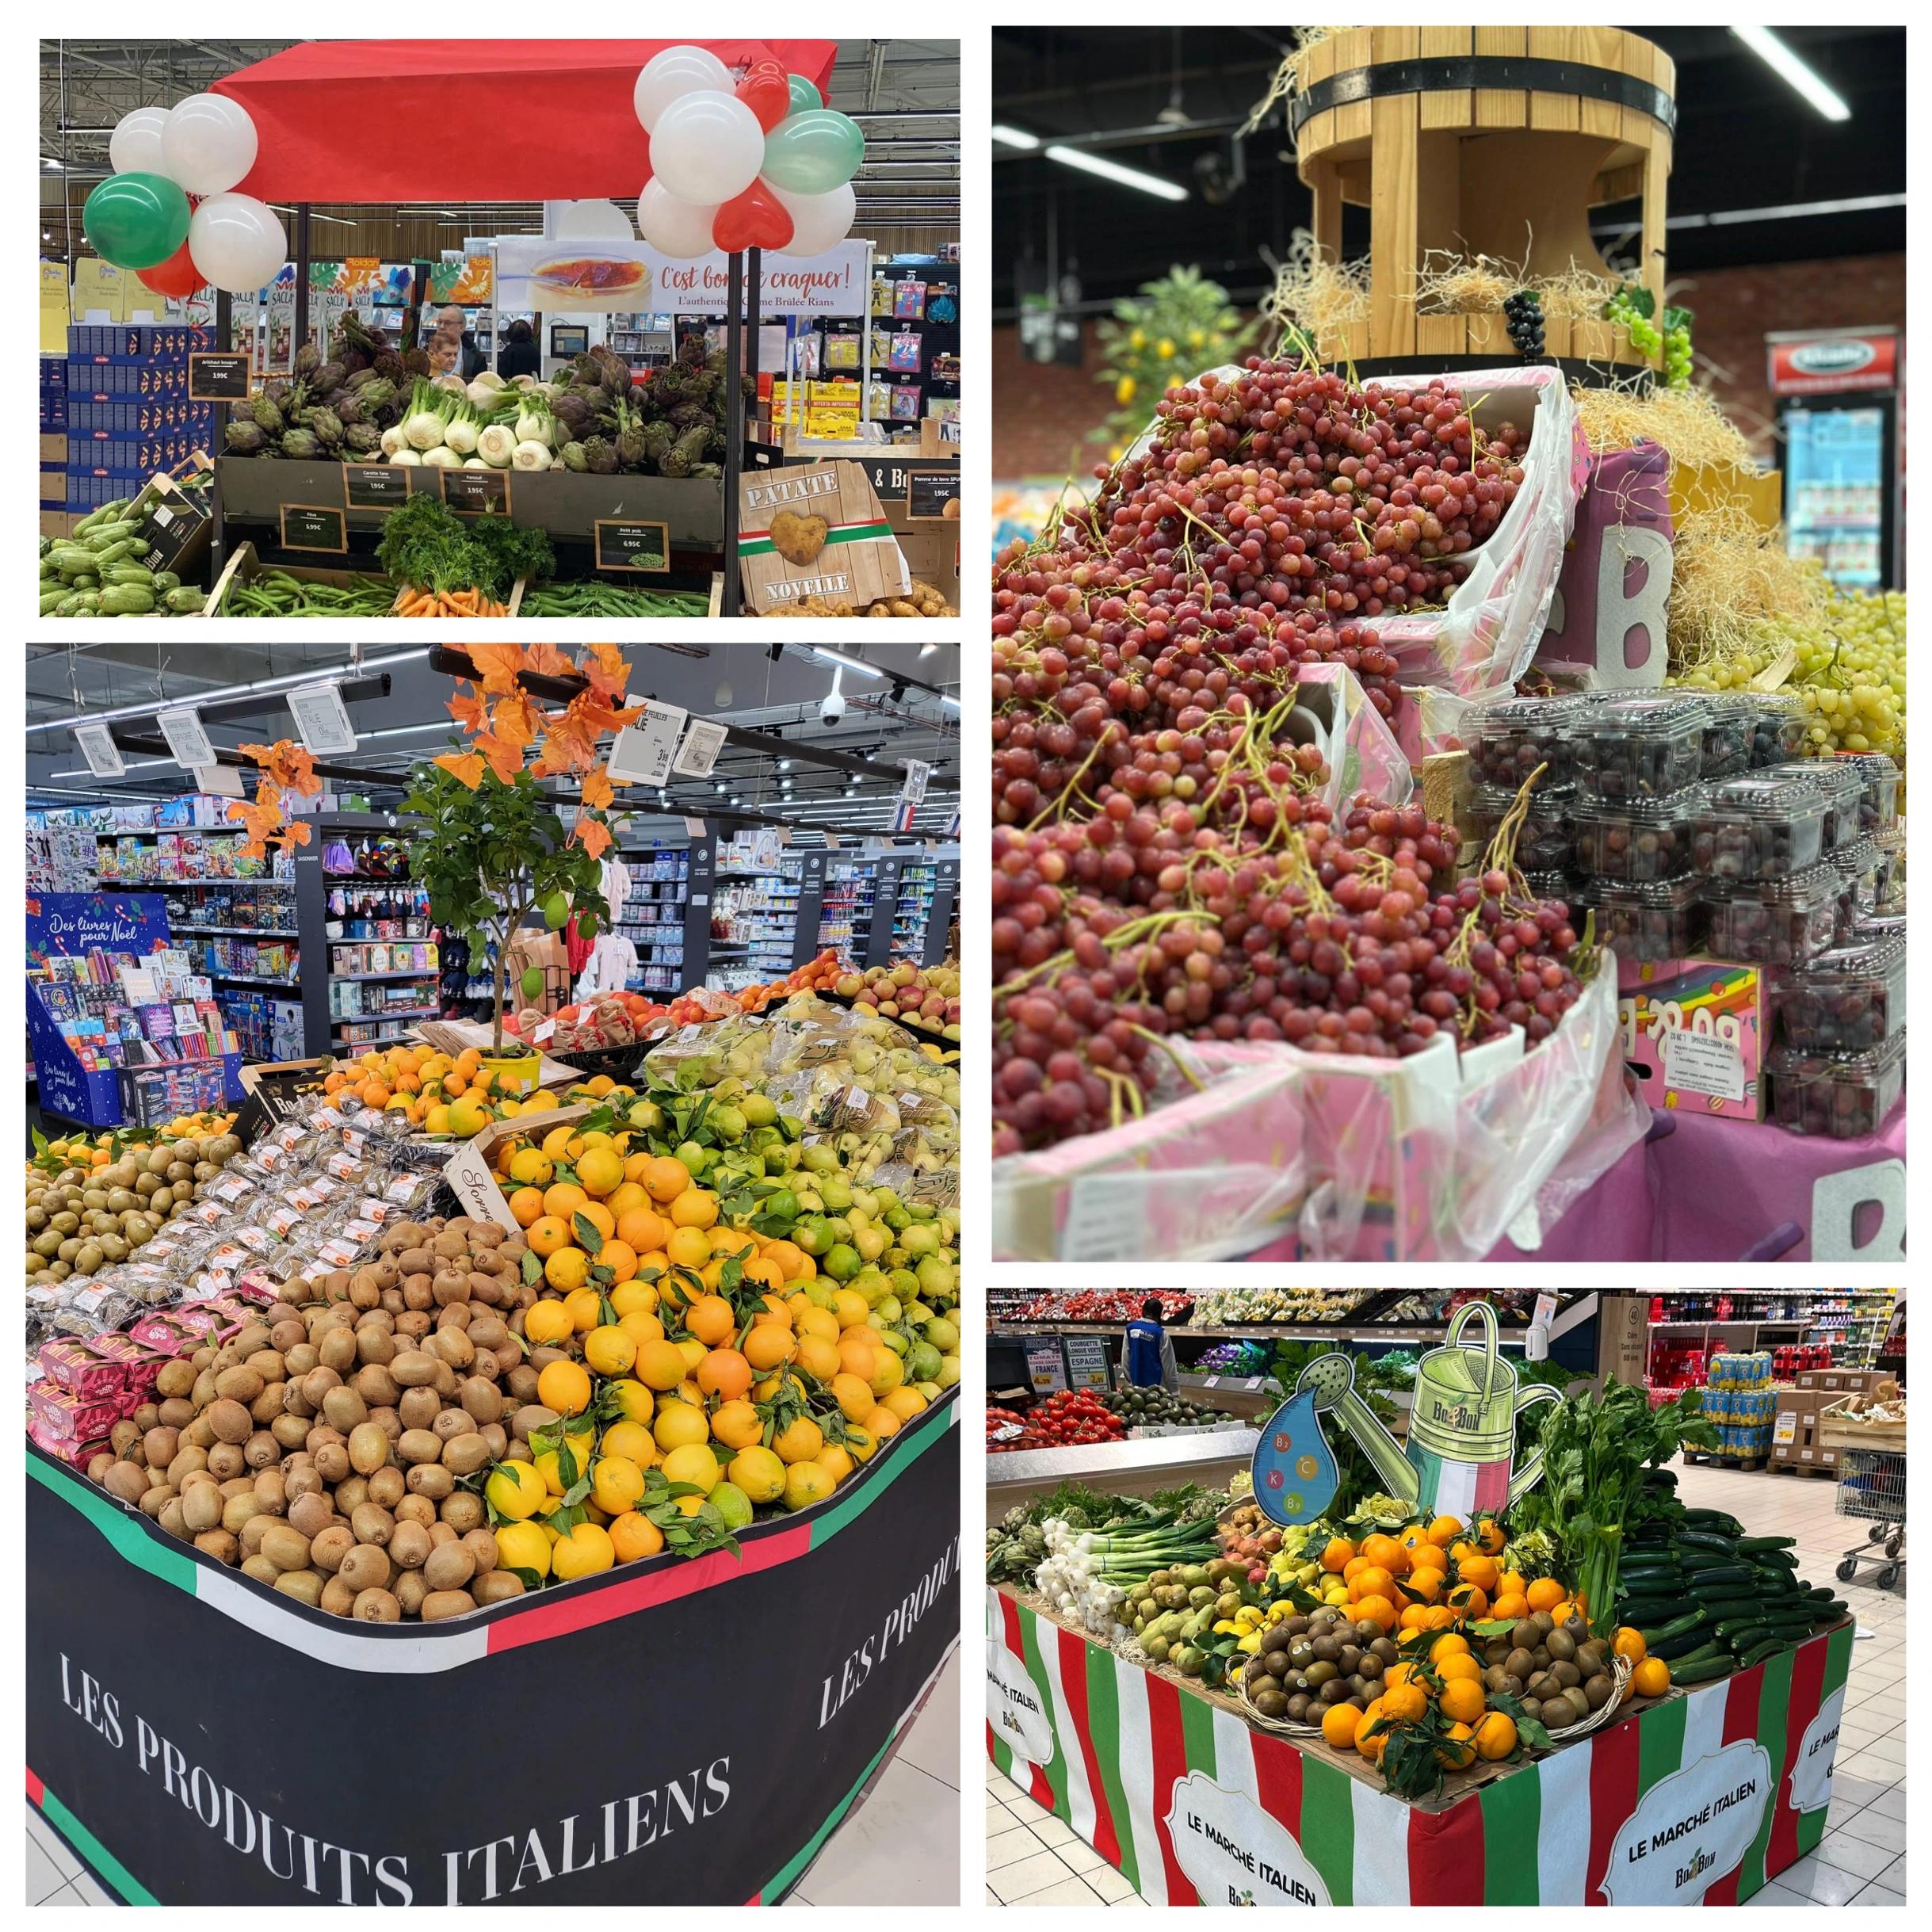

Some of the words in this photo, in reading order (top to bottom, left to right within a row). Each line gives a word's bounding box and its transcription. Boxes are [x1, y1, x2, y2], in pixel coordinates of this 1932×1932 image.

[661, 265, 698, 291] C'est
[678, 296, 729, 307] L'authentiq
[743, 296, 773, 307] Cme
[775, 296, 805, 307] Brûlée
[808, 296, 834, 307] Rians
[746, 473, 838, 508] PATATE
[875, 468, 884, 488] &
[765, 575, 850, 601] NOVELLE
[50, 914, 75, 934] Des
[78, 917, 113, 931] livres
[80, 931, 109, 948] pour
[111, 920, 138, 942] Noël
[1036, 1365, 1059, 1374] FRANCE
[1071, 1357, 1103, 1365] ESPAGNE
[1270, 1474, 1277, 1484] K
[1301, 1460, 1311, 1474] C
[817, 1634, 876, 1731] LES
[1010, 1688, 1040, 1715] ITALIEN
[1808, 1739, 1820, 1758] LE
[59, 1653, 123, 1751] LES
[136, 1715, 413, 1907] PRODUITS
[441, 1756, 732, 1907] ITALIENS
[1628, 1839, 1647, 1863] LE
[1651, 1803, 1711, 1852] MARCHÉ
[1712, 1778, 1756, 1817] ITALIEN
[1187, 1811, 1202, 1834] LE
[1205, 1823, 1255, 1874] MARCHÉ
[1259, 1861, 1316, 1907] ITALIEN
